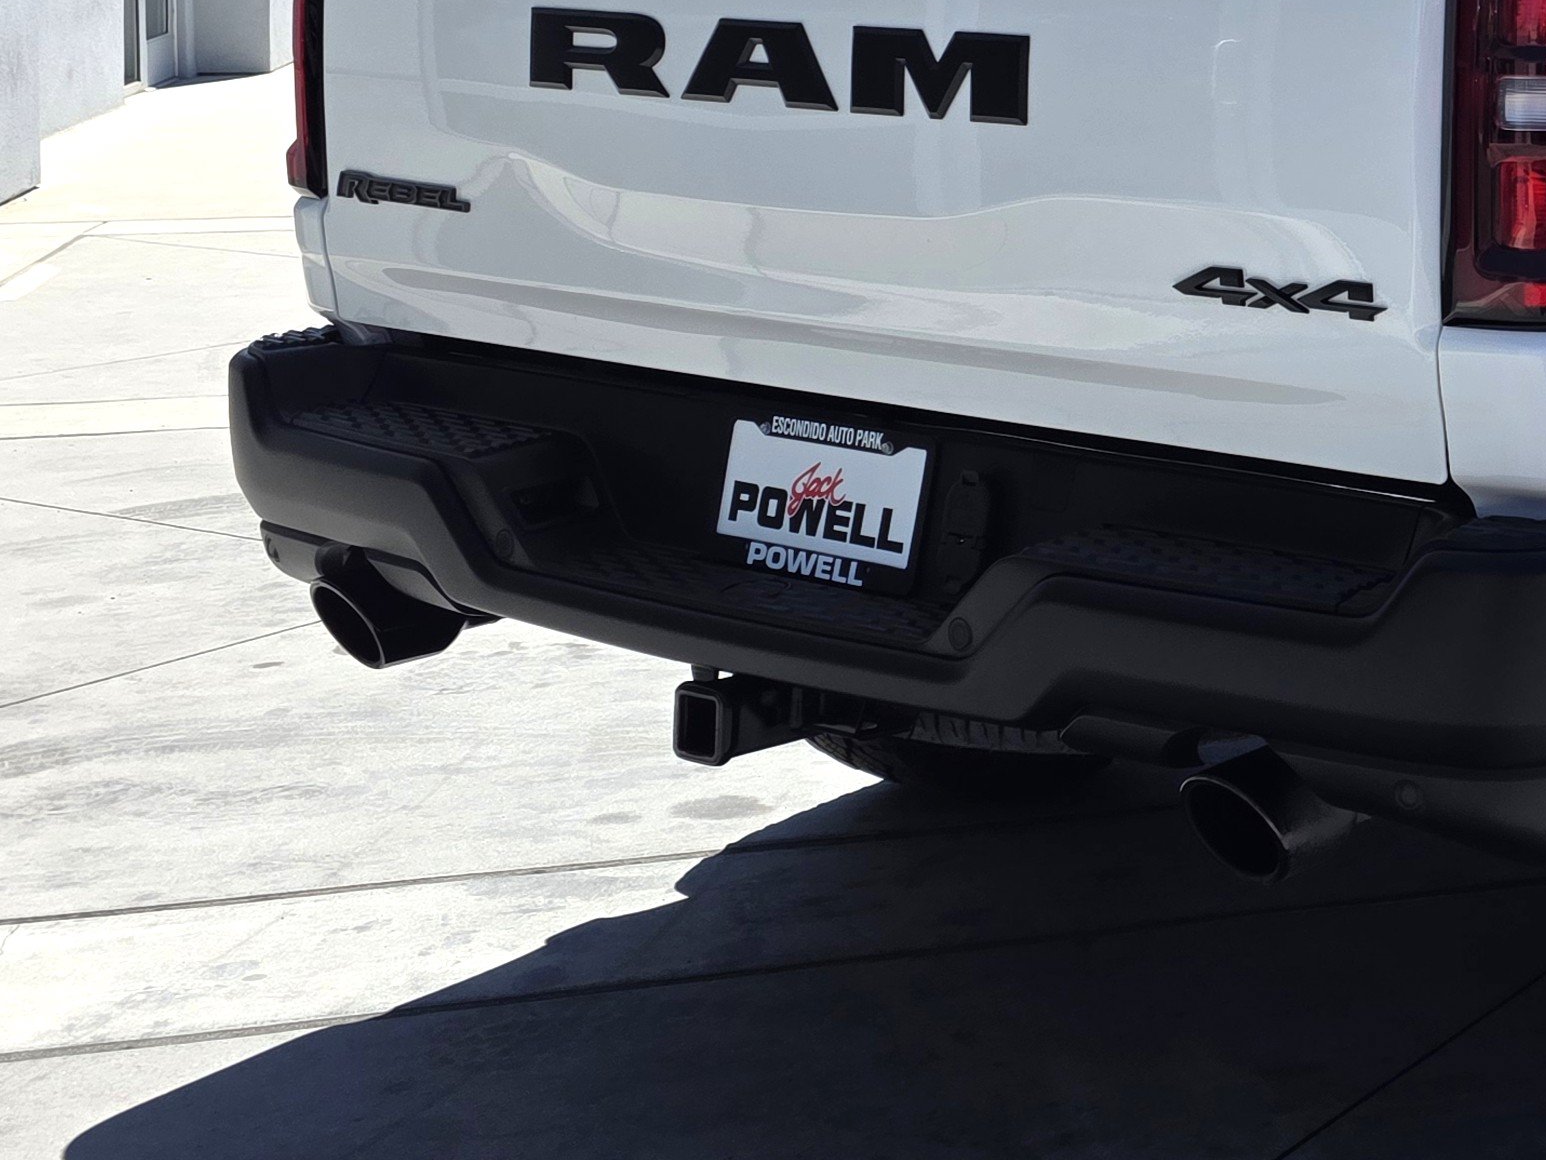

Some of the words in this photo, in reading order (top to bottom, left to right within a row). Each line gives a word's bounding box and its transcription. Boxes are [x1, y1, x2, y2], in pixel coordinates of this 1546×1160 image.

[529, 6, 1030, 126] RAM
[336, 169, 471, 213] REBEL
[771, 415, 827, 442] ESCONDIDO
[827, 424, 855, 446] AUTO
[856, 429, 884, 450] PARK
[787, 461, 847, 517] Jack
[727, 480, 904, 554] POWELL
[746, 541, 863, 587] POWELL
